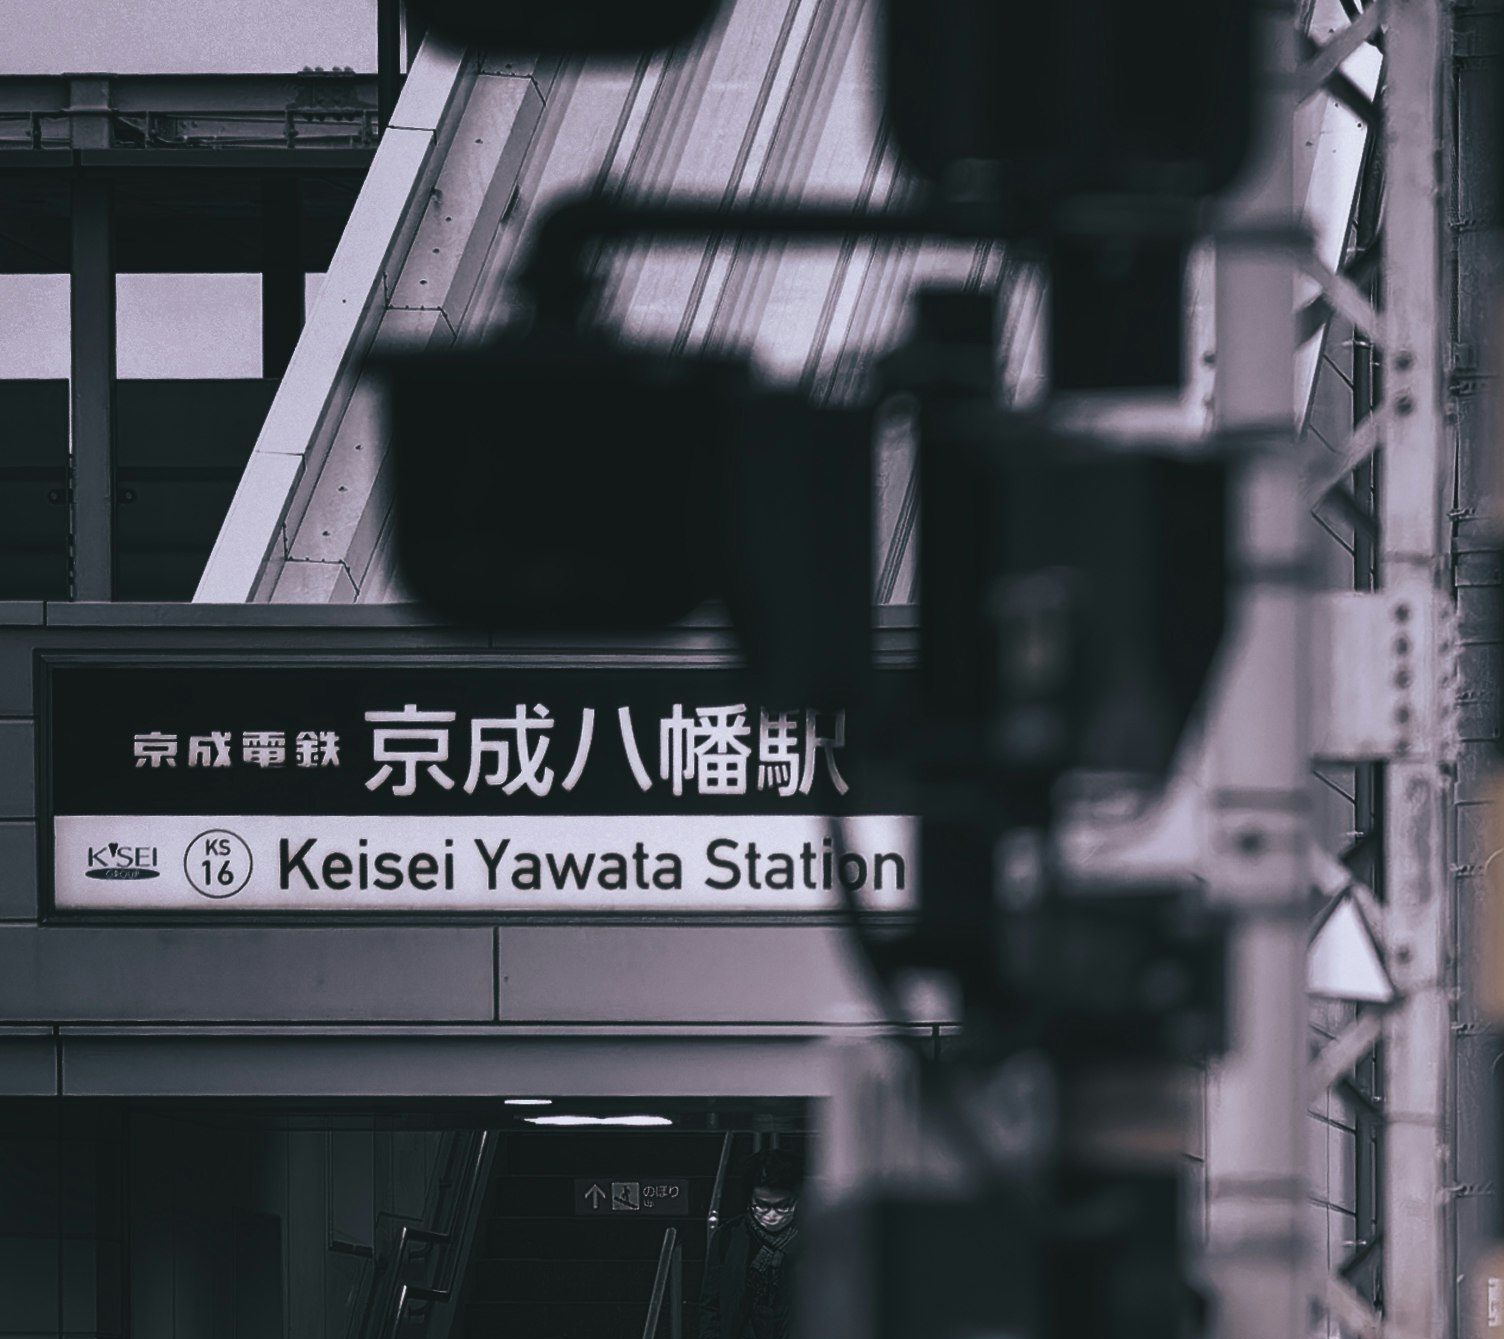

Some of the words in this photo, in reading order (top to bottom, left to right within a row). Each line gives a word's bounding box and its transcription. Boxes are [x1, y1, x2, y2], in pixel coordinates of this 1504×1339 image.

[133, 731, 341, 768] 京成電鉄
[363, 703, 851, 798] 京成八幡駅
[205, 838, 231, 856] KS
[279, 837, 455, 891] Keisei
[476, 837, 683, 891] Yawata
[704, 837, 907, 891] Station
[202, 860, 234, 885] 16
